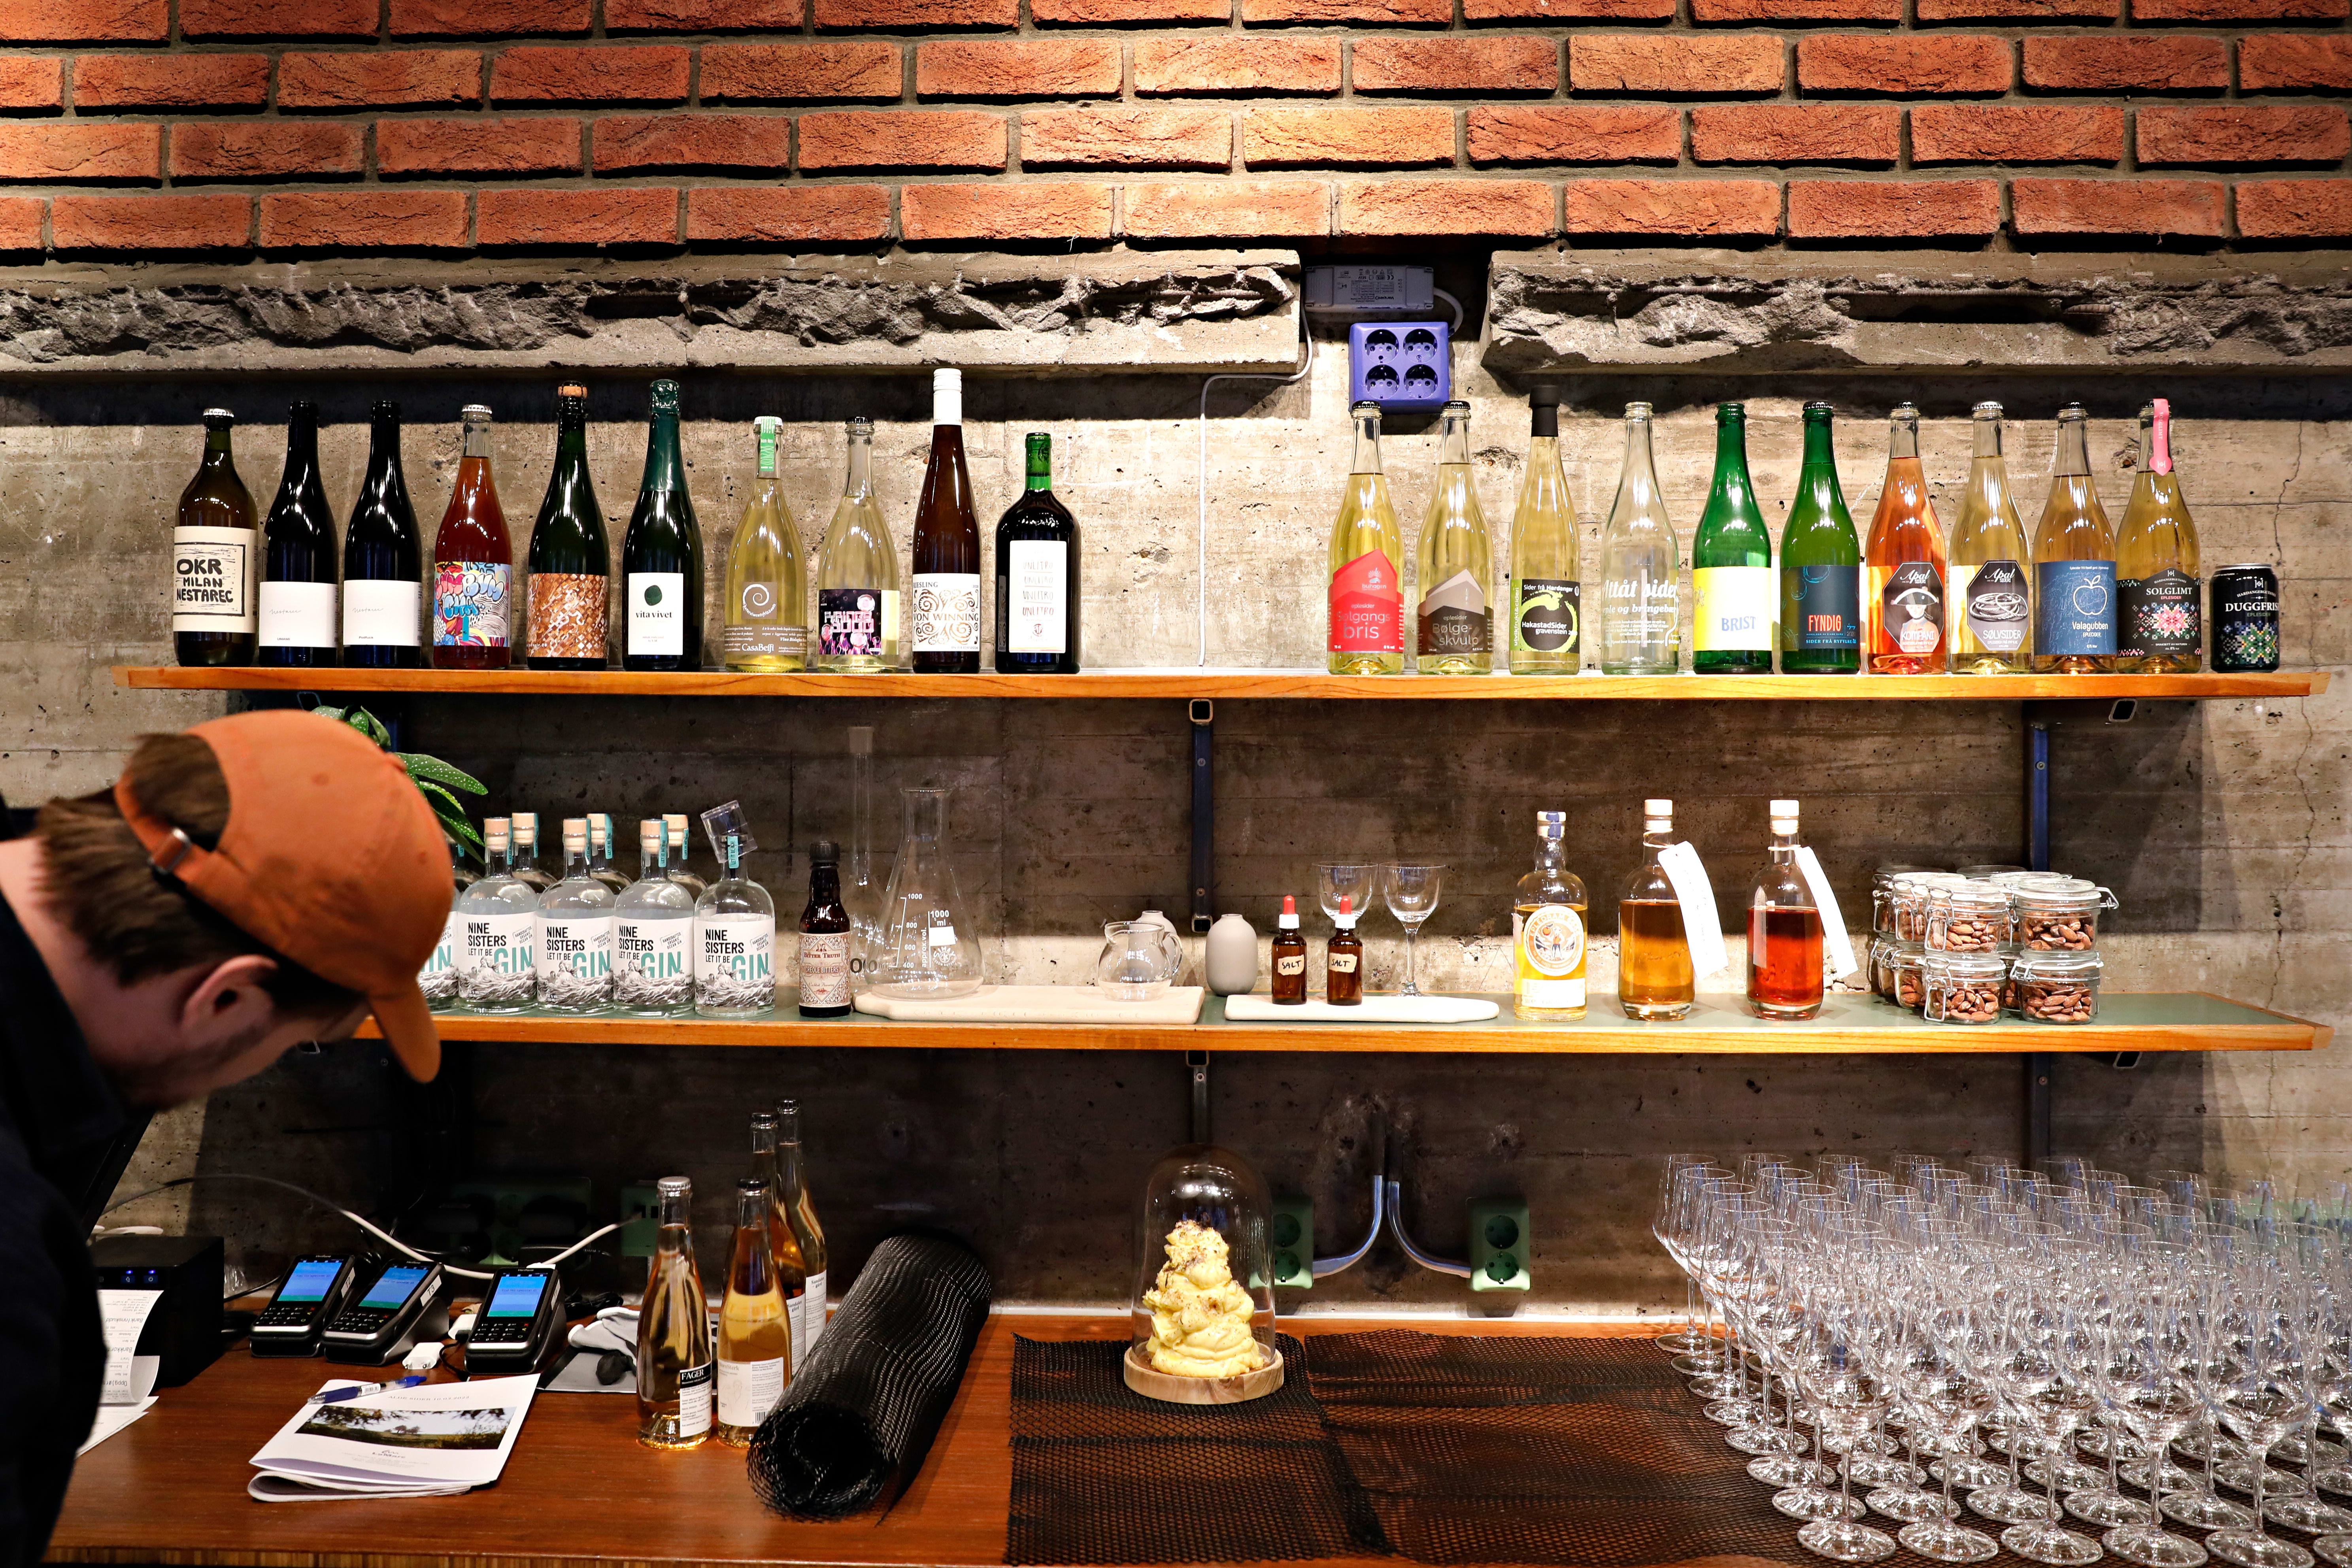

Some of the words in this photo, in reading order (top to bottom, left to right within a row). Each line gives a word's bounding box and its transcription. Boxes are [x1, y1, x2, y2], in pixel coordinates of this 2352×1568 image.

[176, 559, 223, 575] OKR
[183, 577, 223, 587] MILAN
[176, 588, 234, 603] NESTAREC
[2146, 587, 2192, 595] SOLGLIMT
[1617, 606, 1629, 614] og
[2225, 602, 2279, 612] DUGGFRIS
[636, 610, 650, 619] vita
[652, 610, 672, 619] vivet
[913, 613, 929, 621] VON
[933, 613, 979, 621] WINNING
[1433, 623, 1472, 634] Bølge-
[1522, 621, 1567, 629] HakastadSider
[1721, 616, 1756, 632] BRIST
[1808, 615, 1842, 632] FYNDIG
[2072, 621, 2108, 631] Valagubben
[1344, 623, 1379, 639] bris
[1901, 631, 1934, 640] KOMPANI
[1983, 629, 2021, 640] SØLVSIDER
[1439, 636, 1479, 647] skvulp
[930, 910, 949, 918] 1000
[468, 922, 490, 934] NINE
[1529, 913, 1565, 937] EPLEDRAM
[547, 926, 568, 938] NINE
[619, 925, 638, 938] NINE
[705, 928, 727, 942] NINE
[468, 935, 506, 947] SISTERS
[547, 940, 585, 951] SISTERS
[619, 938, 653, 951] SISTERS
[705, 942, 744, 954] SISTERS
[933, 946, 956, 958] SIMAX
[468, 947, 477, 956] LET
[494, 945, 532, 974] GIN
[572, 949, 610, 978] GIN
[627, 951, 632, 959] IT
[633, 952, 640, 960] BE
[641, 951, 681, 978] GIN
[1282, 960, 1302, 969] SALT
[1331, 958, 1350, 968] SALT
[705, 955, 714, 963] LET
[731, 953, 769, 981] GIN
[345, 1277, 351, 1288] T2
[427, 1285, 435, 1296] T3
[681, 1368, 704, 1380] FAGER
